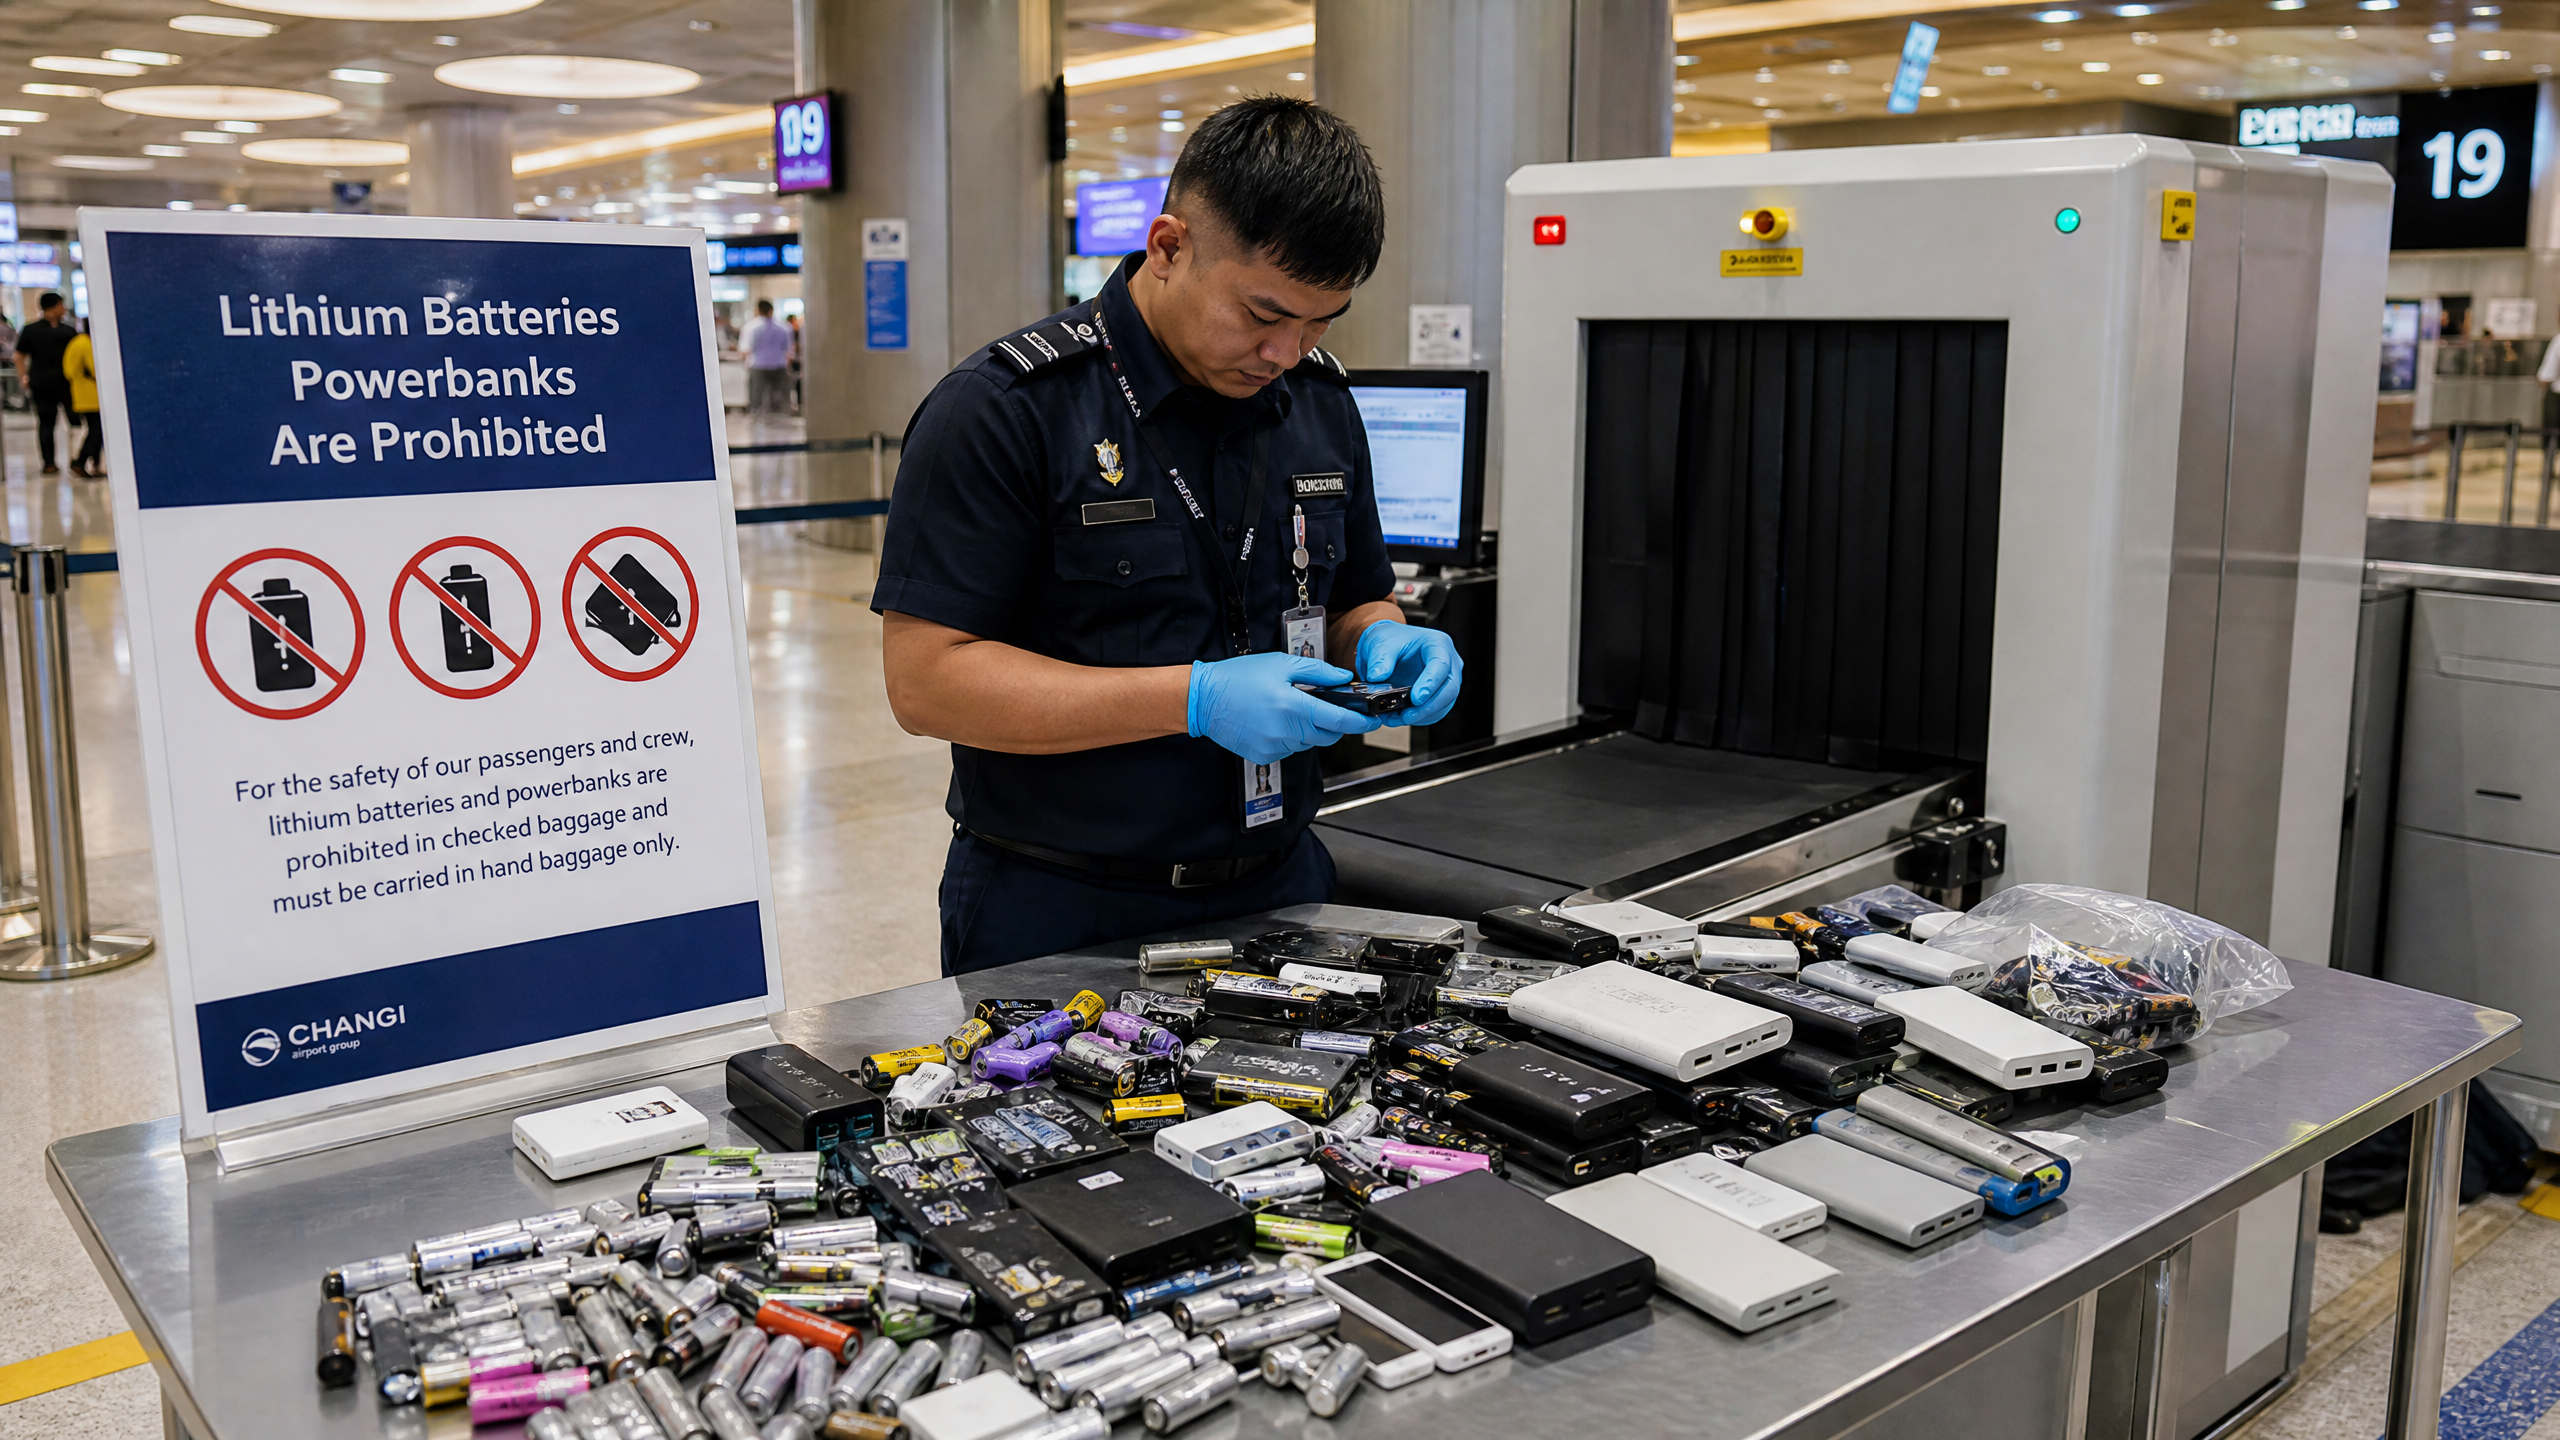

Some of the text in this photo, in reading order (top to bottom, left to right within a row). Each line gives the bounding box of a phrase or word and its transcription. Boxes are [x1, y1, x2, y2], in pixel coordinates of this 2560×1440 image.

[2423, 129, 2506, 199] 19
[220, 293, 620, 336] Lithium Batteries
[292, 356, 577, 401] Powerbanks
[270, 414, 607, 466] Are Prohibited
[235, 730, 695, 802] For the safety of our passengers and crew,
[269, 766, 668, 836] lithium batteries and powerbanks are
[286, 797, 668, 879] prohibited in checked baggage and
[273, 832, 681, 914] must be carried in hand baggage only.
[288, 1004, 406, 1046] CHANGI
[291, 1038, 361, 1059] airport group
